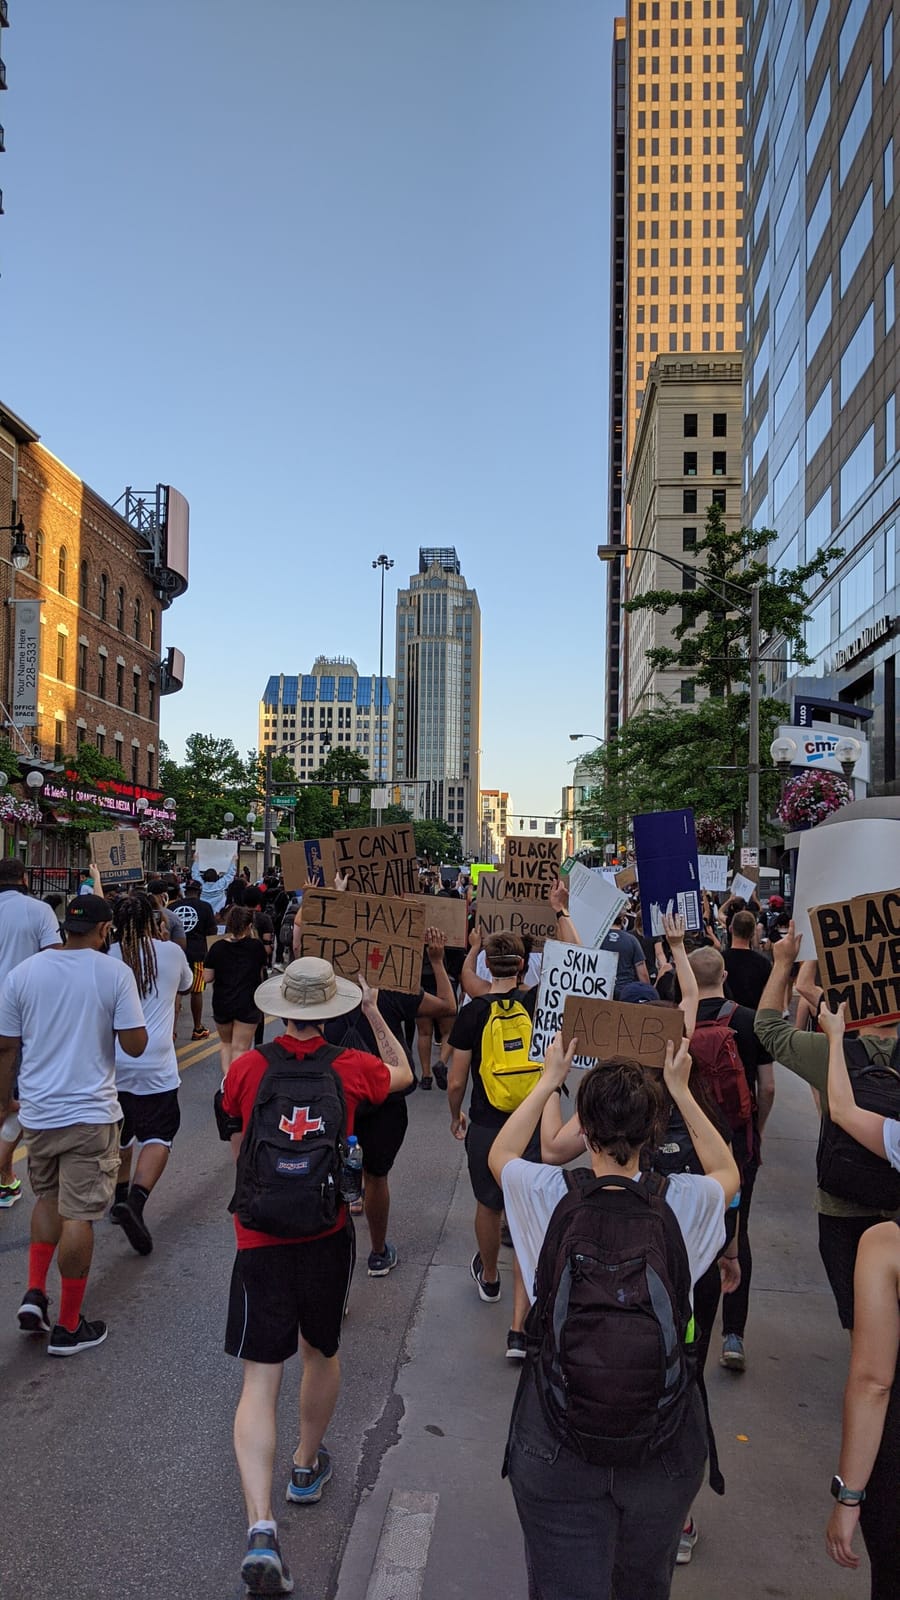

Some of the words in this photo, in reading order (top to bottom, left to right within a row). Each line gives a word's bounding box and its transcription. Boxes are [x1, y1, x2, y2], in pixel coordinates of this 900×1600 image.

[18, 629, 26, 649] Here
[861, 615, 888, 650] MUTUAL
[18, 651, 26, 677] Name
[26, 636, 37, 688] 228-5331
[17, 683, 25, 697] Your
[336, 837, 353, 861] I
[359, 830, 410, 858] CAN'T
[508, 840, 559, 860] BLACK
[340, 857, 423, 896] BREATHE
[510, 860, 559, 882] LIVES
[305, 895, 338, 928] I
[354, 900, 423, 938] HAVE
[479, 914, 504, 934] NO
[510, 912, 555, 937] Peace
[300, 934, 382, 981] FIRST
[563, 949, 598, 974] SKIN
[550, 967, 608, 998] COLOR
[545, 989, 561, 1009] IS
[572, 1007, 666, 1055] ACAB
